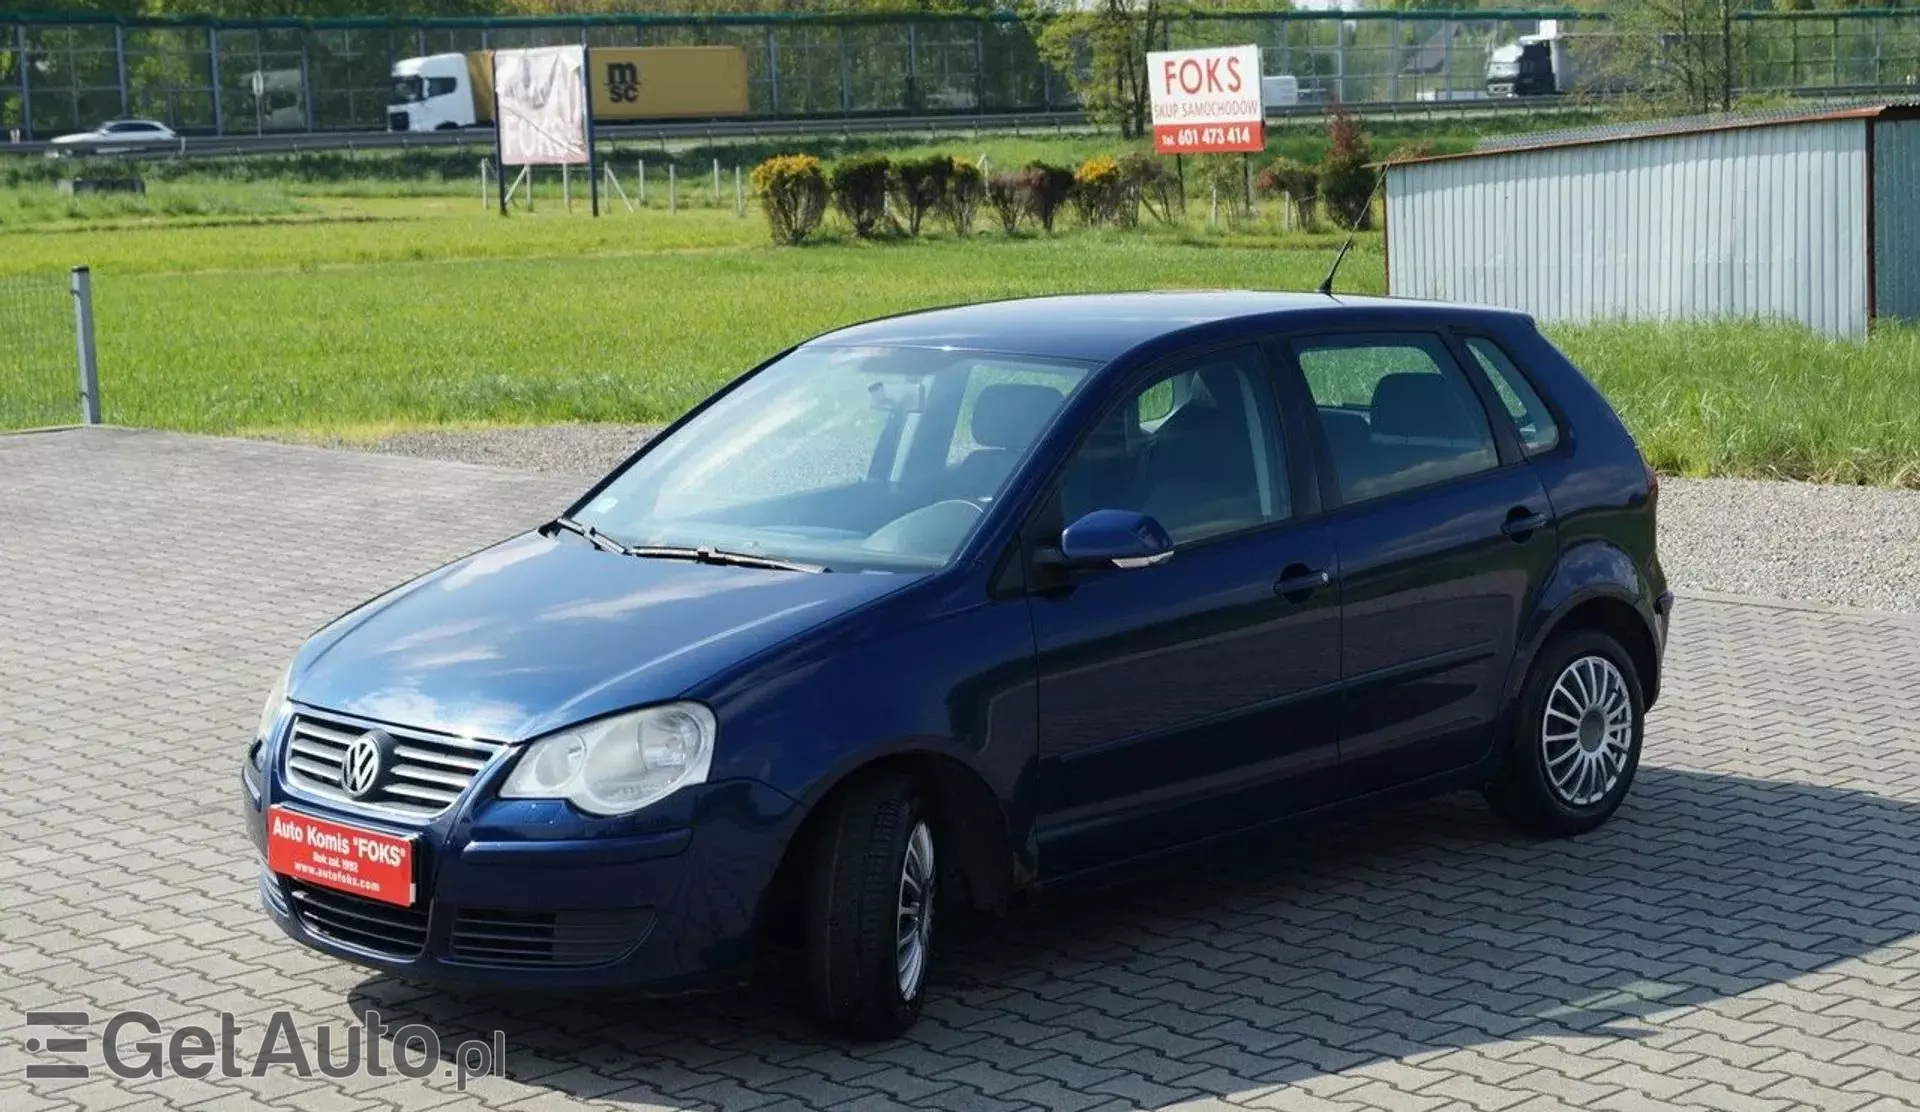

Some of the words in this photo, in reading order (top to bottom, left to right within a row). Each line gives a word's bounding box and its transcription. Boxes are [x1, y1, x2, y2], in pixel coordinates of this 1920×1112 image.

[1164, 56, 1241, 95] FOKS
[1154, 102, 1179, 119] SKUP
[1178, 128, 1198, 146] 601
[1201, 127, 1225, 145] 473
[1227, 126, 1250, 144] 414
[272, 815, 303, 843] Auto
[306, 824, 350, 855] Komis
[352, 836, 406, 867] "FOKS"
[294, 861, 380, 892] www.autofoks.com
